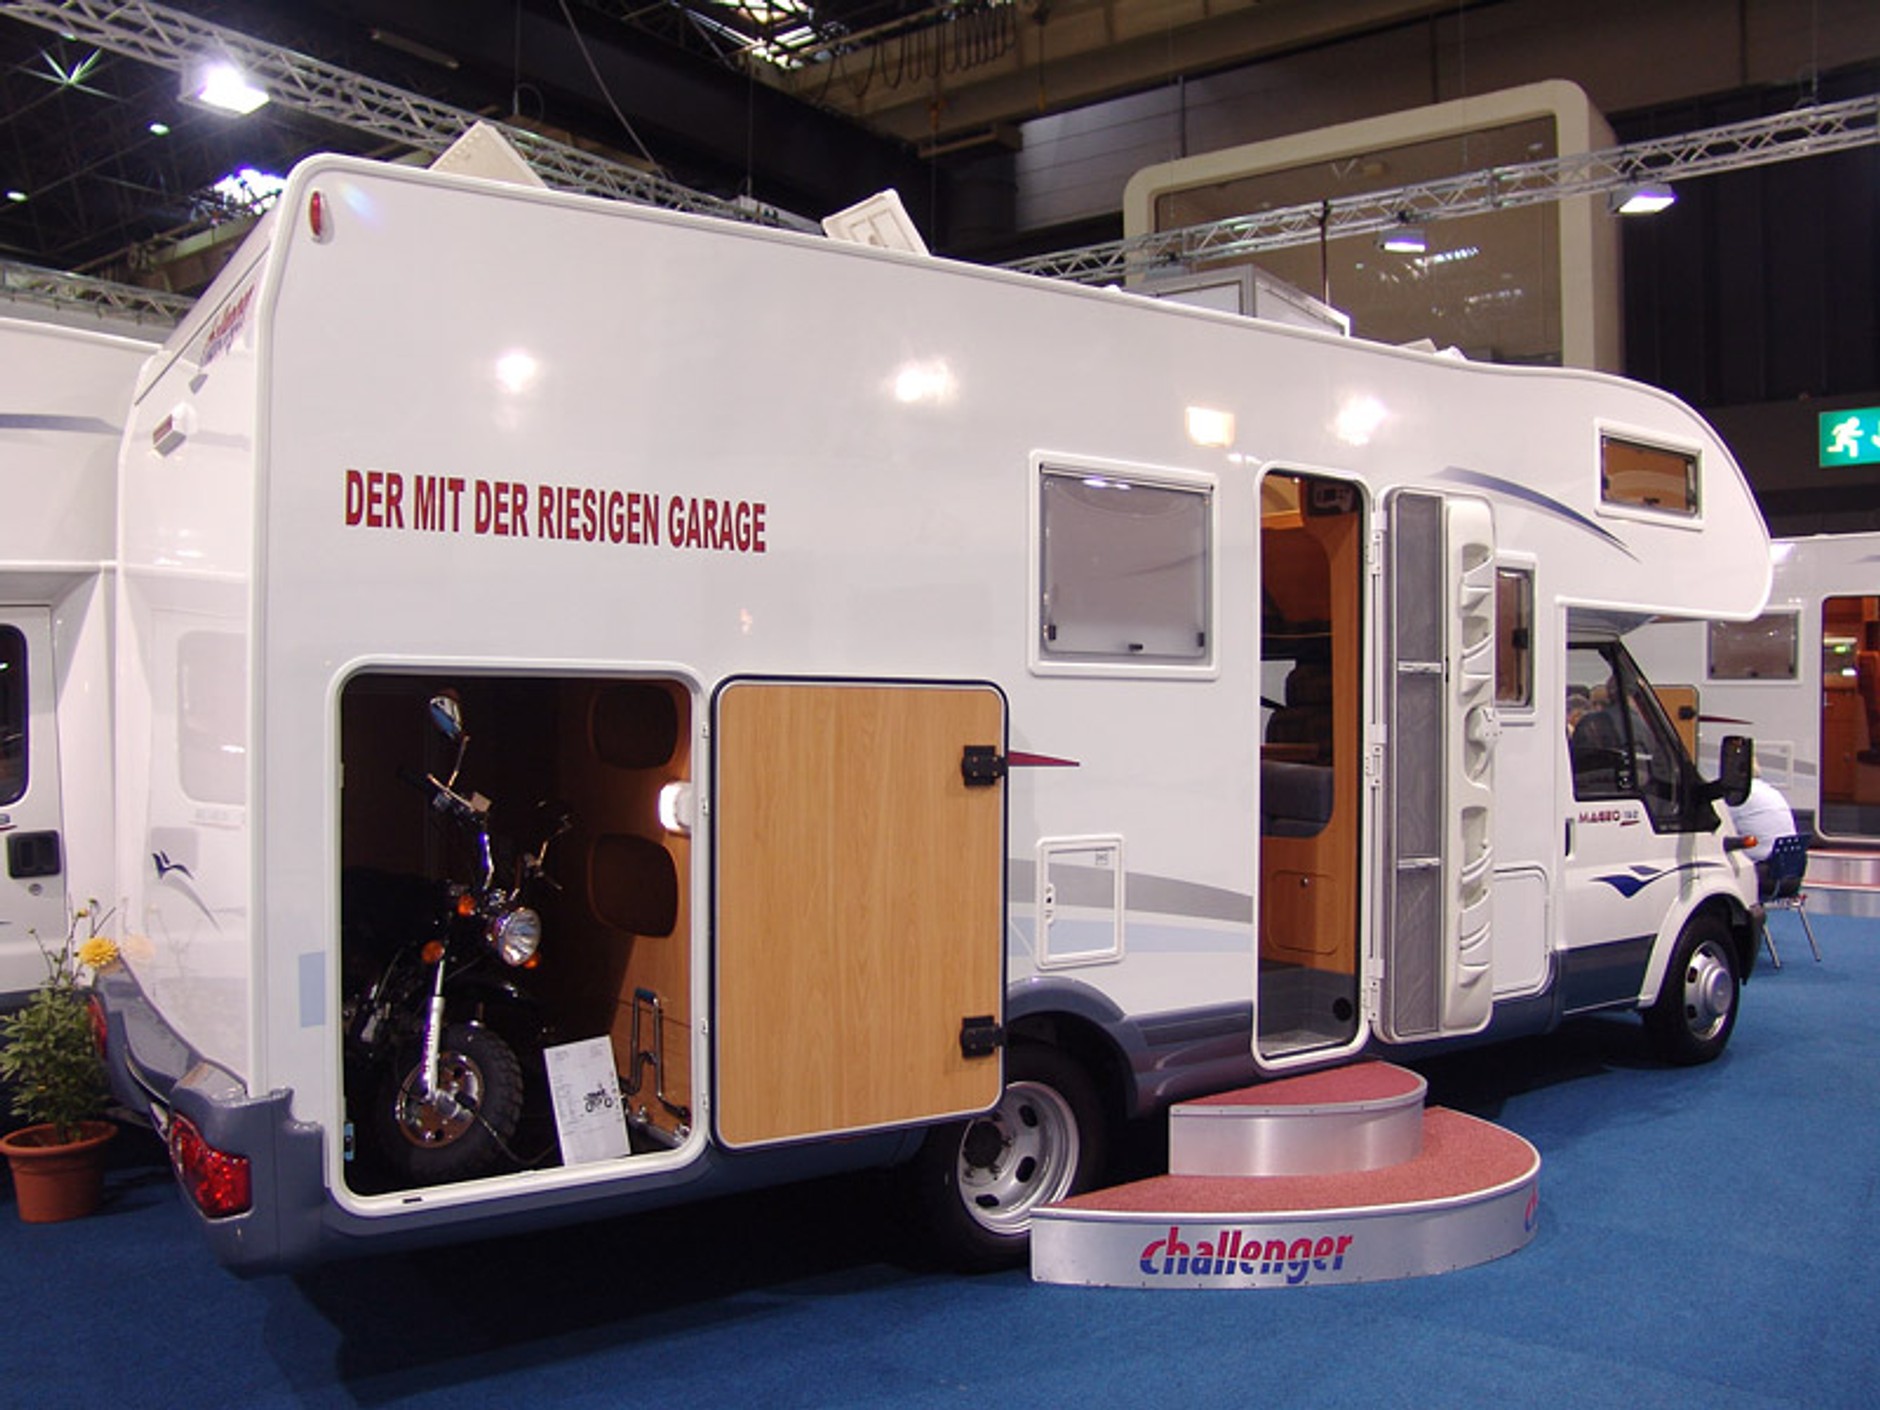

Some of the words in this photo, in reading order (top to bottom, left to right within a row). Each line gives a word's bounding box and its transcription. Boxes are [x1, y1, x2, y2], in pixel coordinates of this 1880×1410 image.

[345, 469, 404, 528] DER
[414, 475, 465, 532] MIT
[475, 480, 528, 537] DER
[538, 486, 659, 545] RIESIGEN
[668, 496, 766, 552] GARAGE
[1140, 1226, 1353, 1285] challenger
